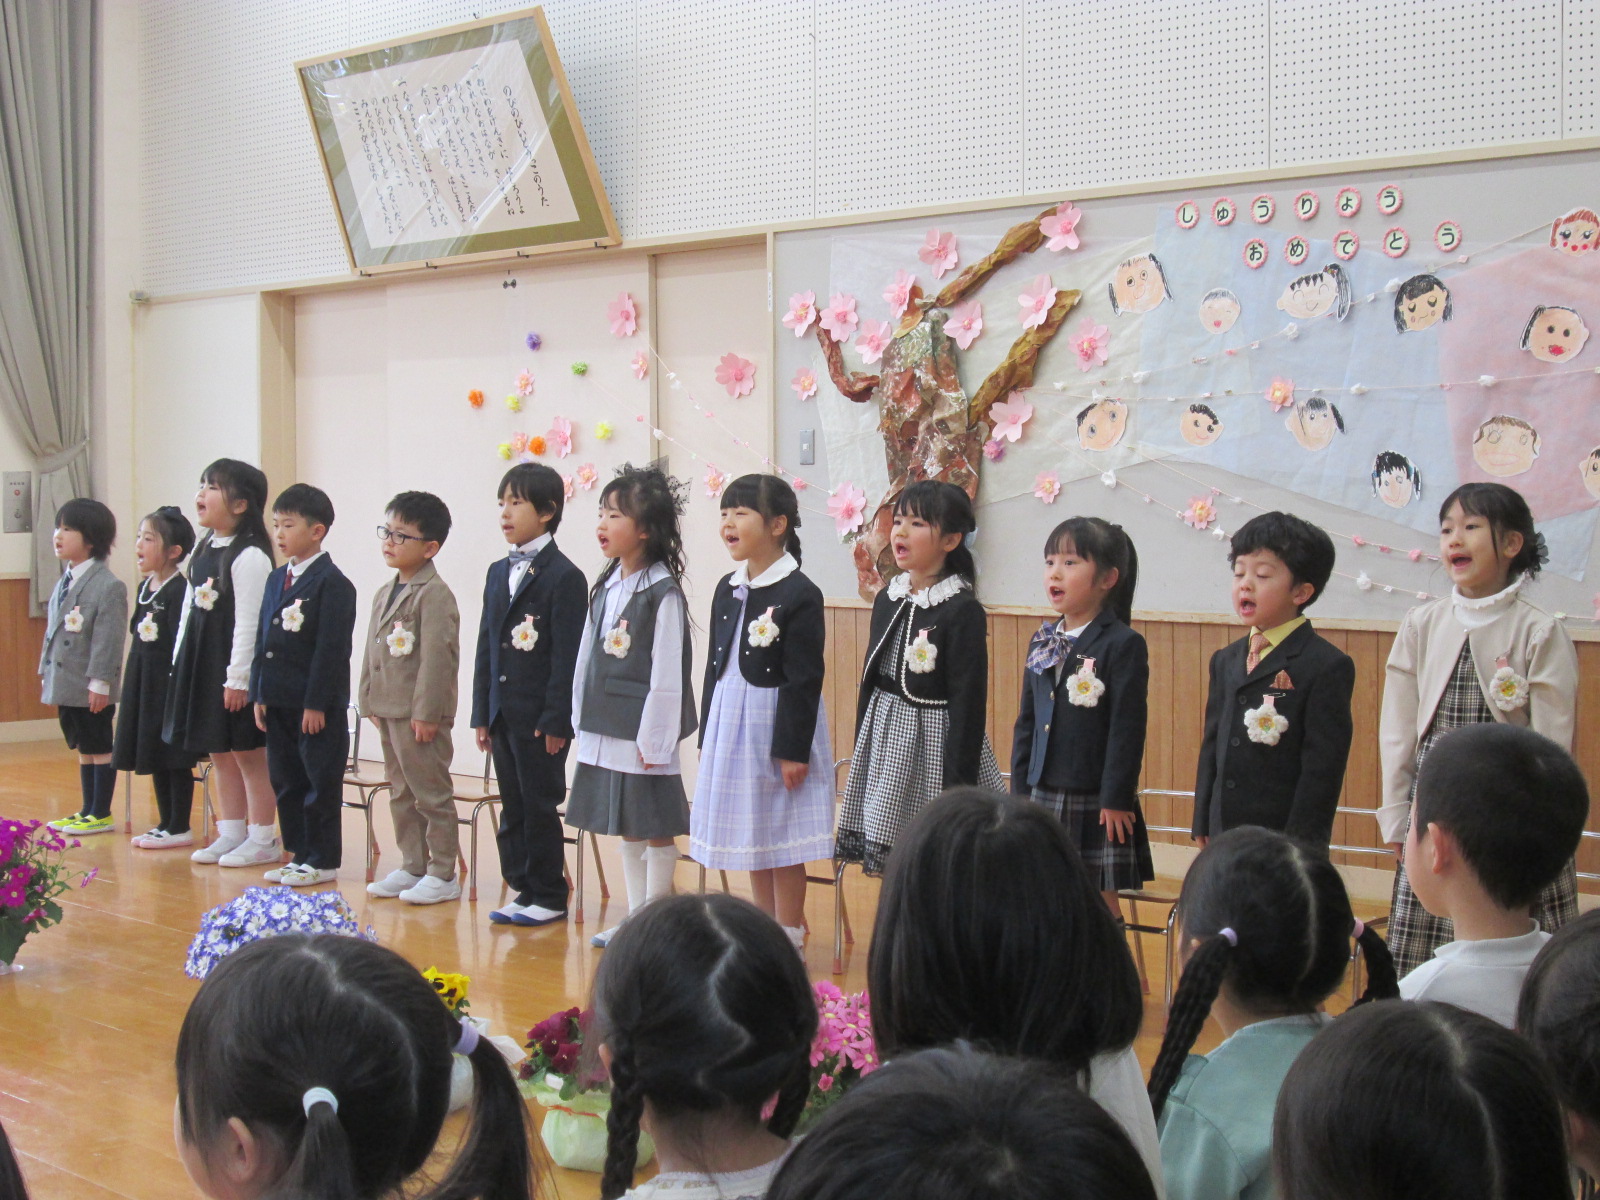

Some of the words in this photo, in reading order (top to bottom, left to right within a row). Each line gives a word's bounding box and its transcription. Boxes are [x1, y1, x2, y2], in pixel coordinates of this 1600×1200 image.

[1181, 190, 1397, 223] しゅうりょう
[1248, 227, 1456, 262] おめでとう
